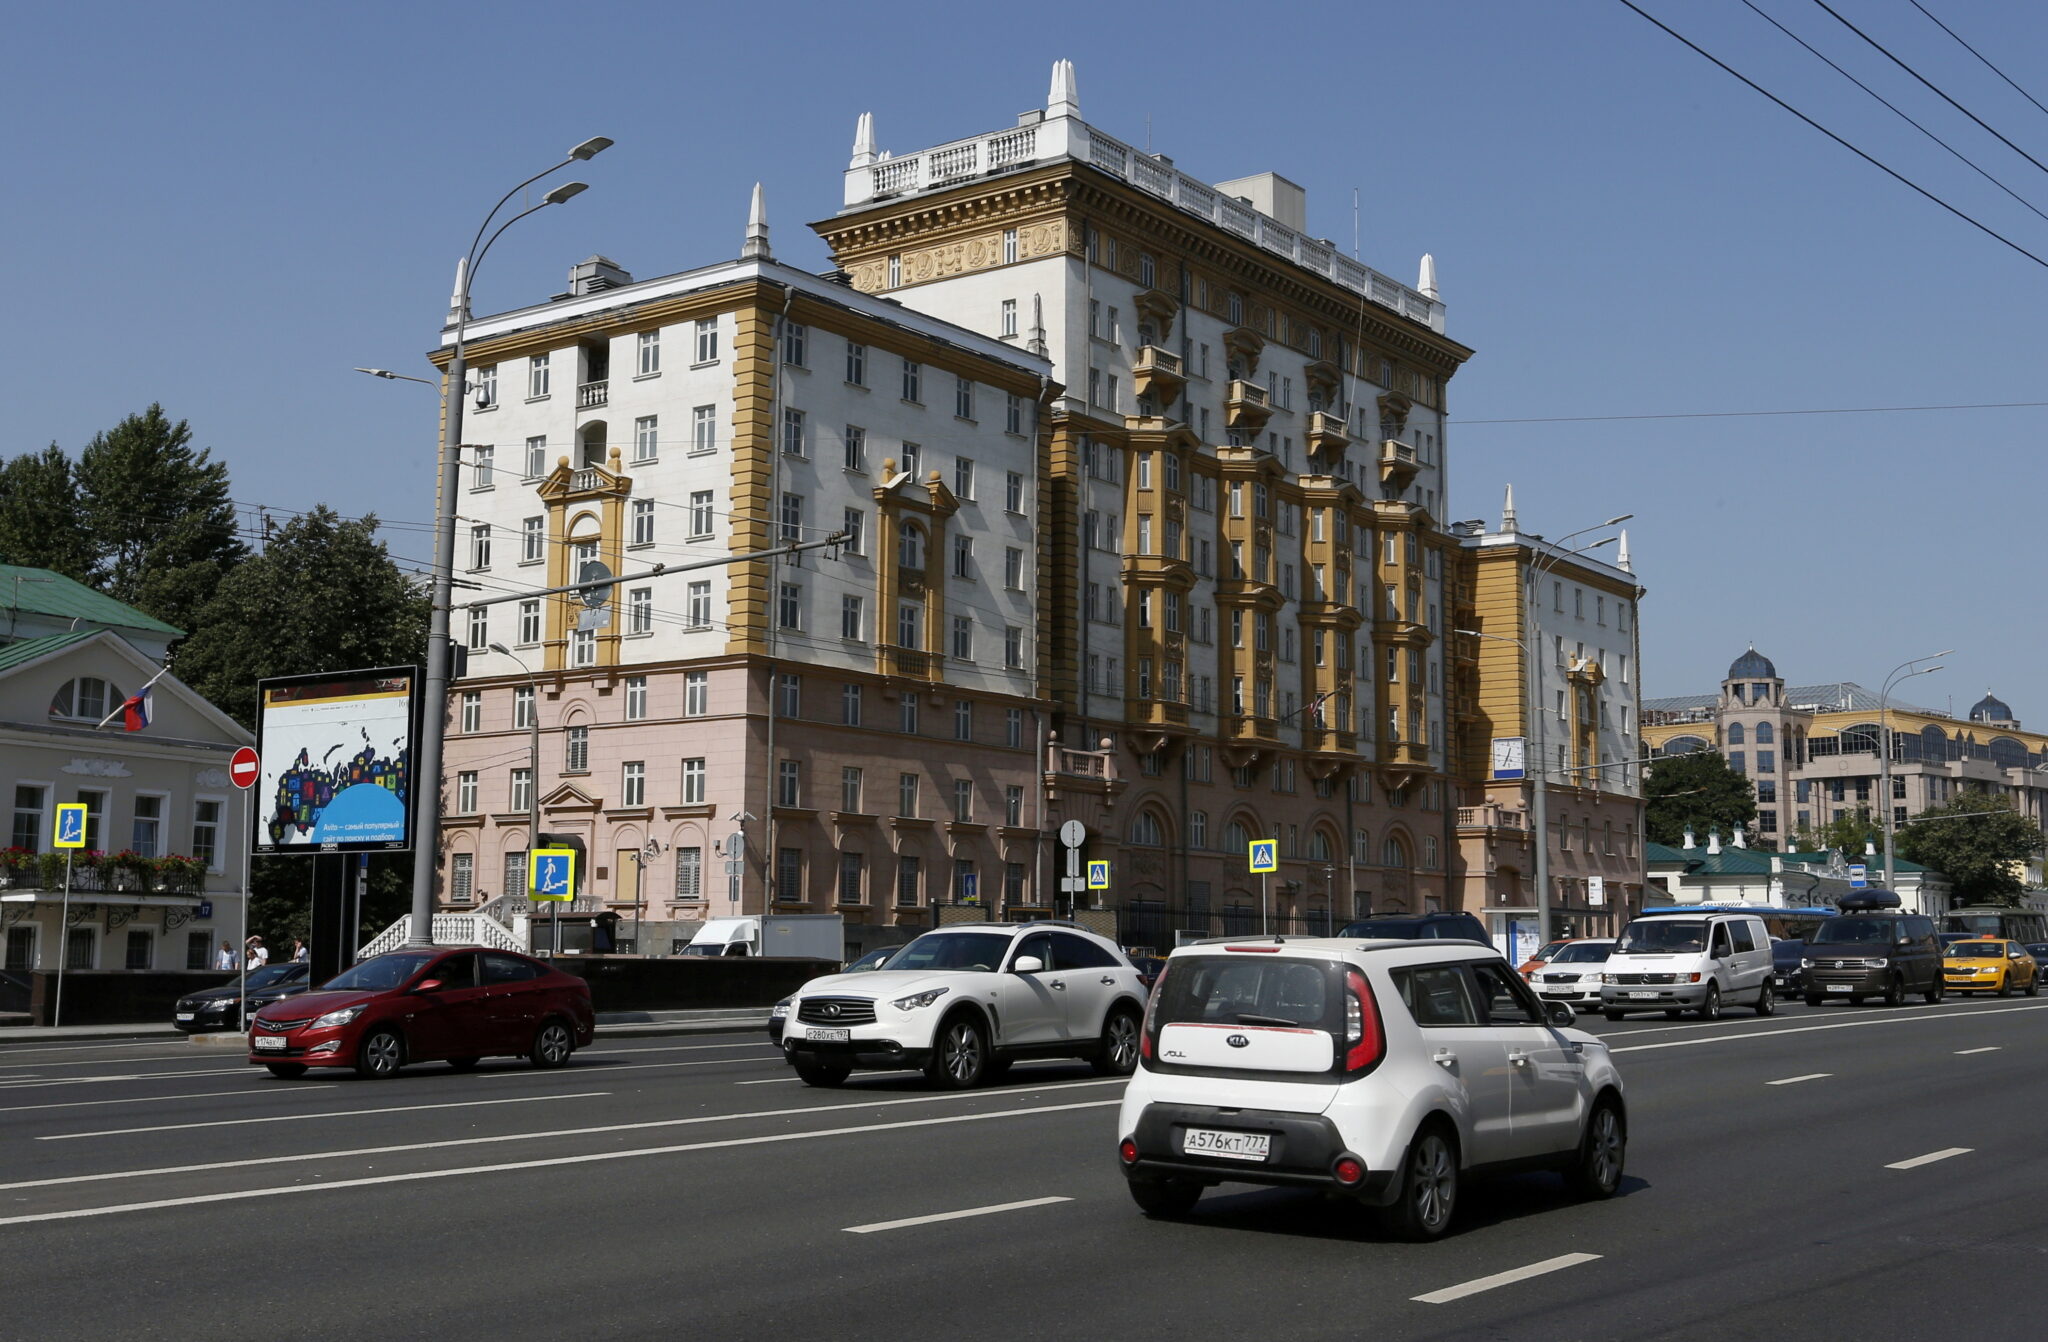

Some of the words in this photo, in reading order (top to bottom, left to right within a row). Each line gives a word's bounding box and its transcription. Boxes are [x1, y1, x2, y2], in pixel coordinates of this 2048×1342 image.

[323, 823, 338, 831] Avito
[344, 822, 364, 831] самый
[364, 820, 400, 831] популярный
[323, 834, 335, 843] сайт
[370, 832, 396, 841] подбору
[202, 905, 210, 916] 17
[1229, 1037, 1246, 1046] KIA
[1163, 1050, 1187, 1058] SOUL
[1188, 1132, 1242, 1151] А576КТ
[1245, 1135, 1266, 1149] 777
